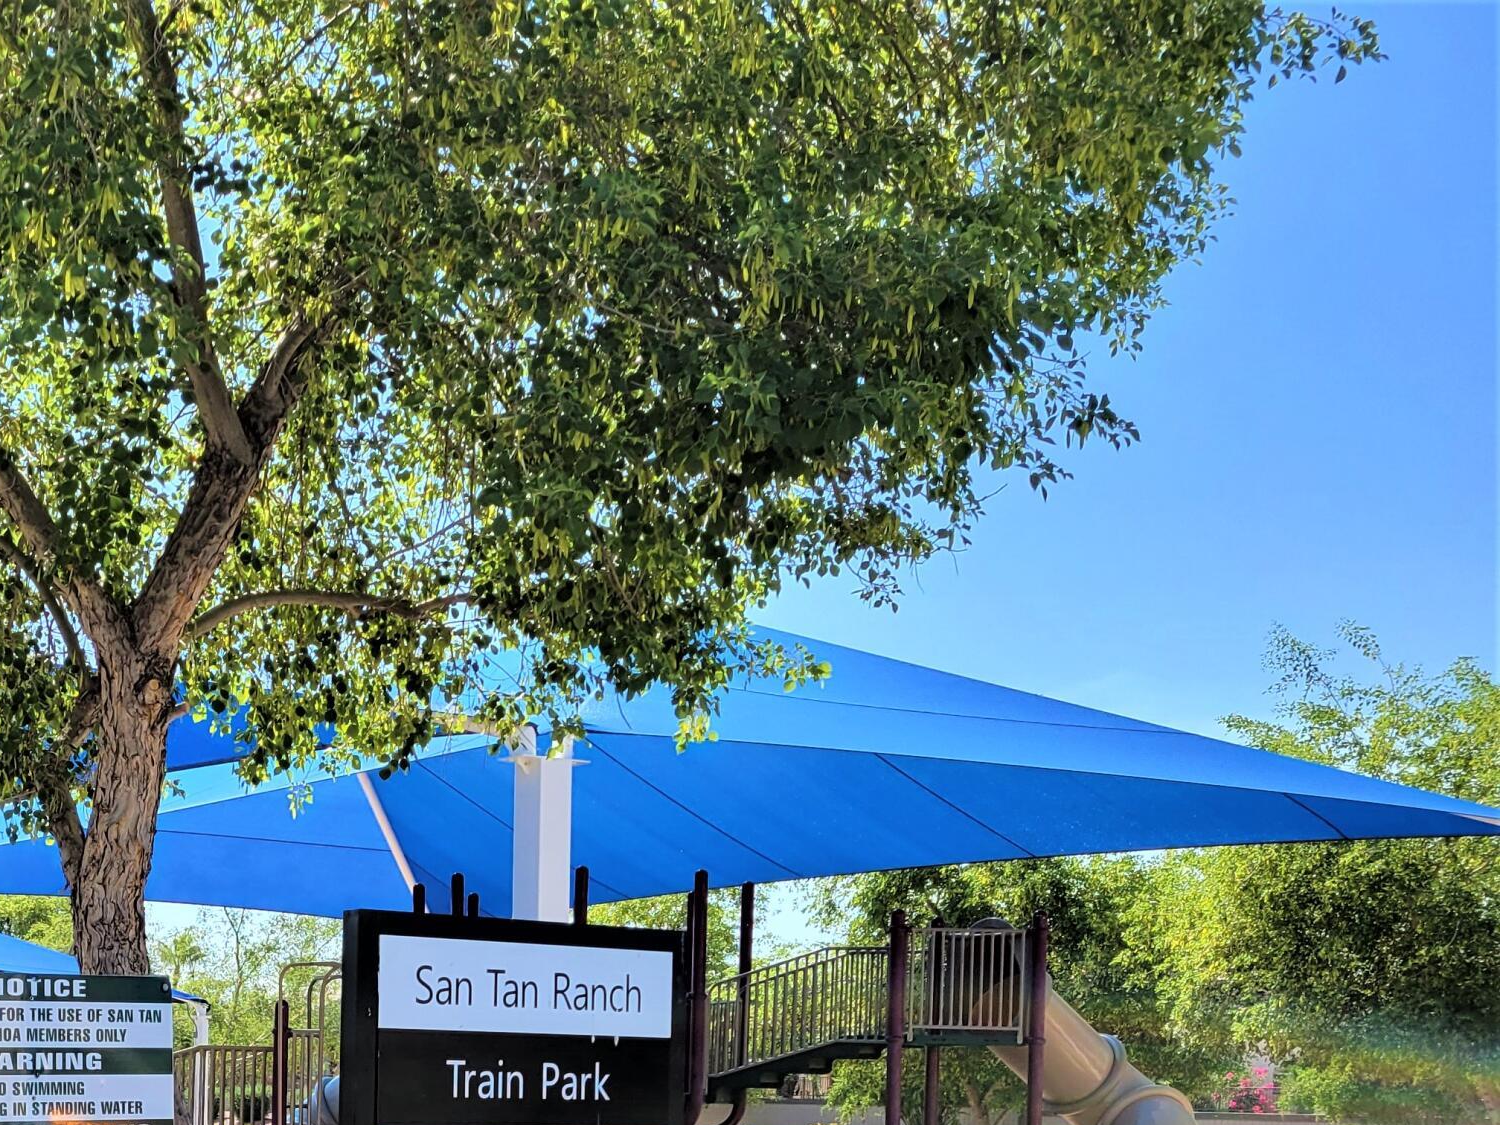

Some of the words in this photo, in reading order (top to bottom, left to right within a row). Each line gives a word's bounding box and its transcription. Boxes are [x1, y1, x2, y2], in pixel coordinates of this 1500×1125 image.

[415, 965, 472, 1005] San
[487, 969, 538, 1008] Tan
[553, 972, 642, 1013] Ranch
[0, 1008, 25, 1022] FOR
[30, 1008, 53, 1022] THE
[58, 1009, 82, 1023] USE
[87, 1009, 102, 1023] OF
[108, 1009, 133, 1023] SAN
[138, 1009, 162, 1023] TAN
[26, 1028, 91, 1042] MEMBERS
[96, 1029, 127, 1042] ONLY
[446, 1060, 524, 1099] Train
[542, 1061, 611, 1101] Park
[12, 1081, 85, 1096] SWIMMING
[13, 1102, 27, 1116] IN
[32, 1102, 96, 1115] STANDING
[101, 1101, 143, 1114] WATER
